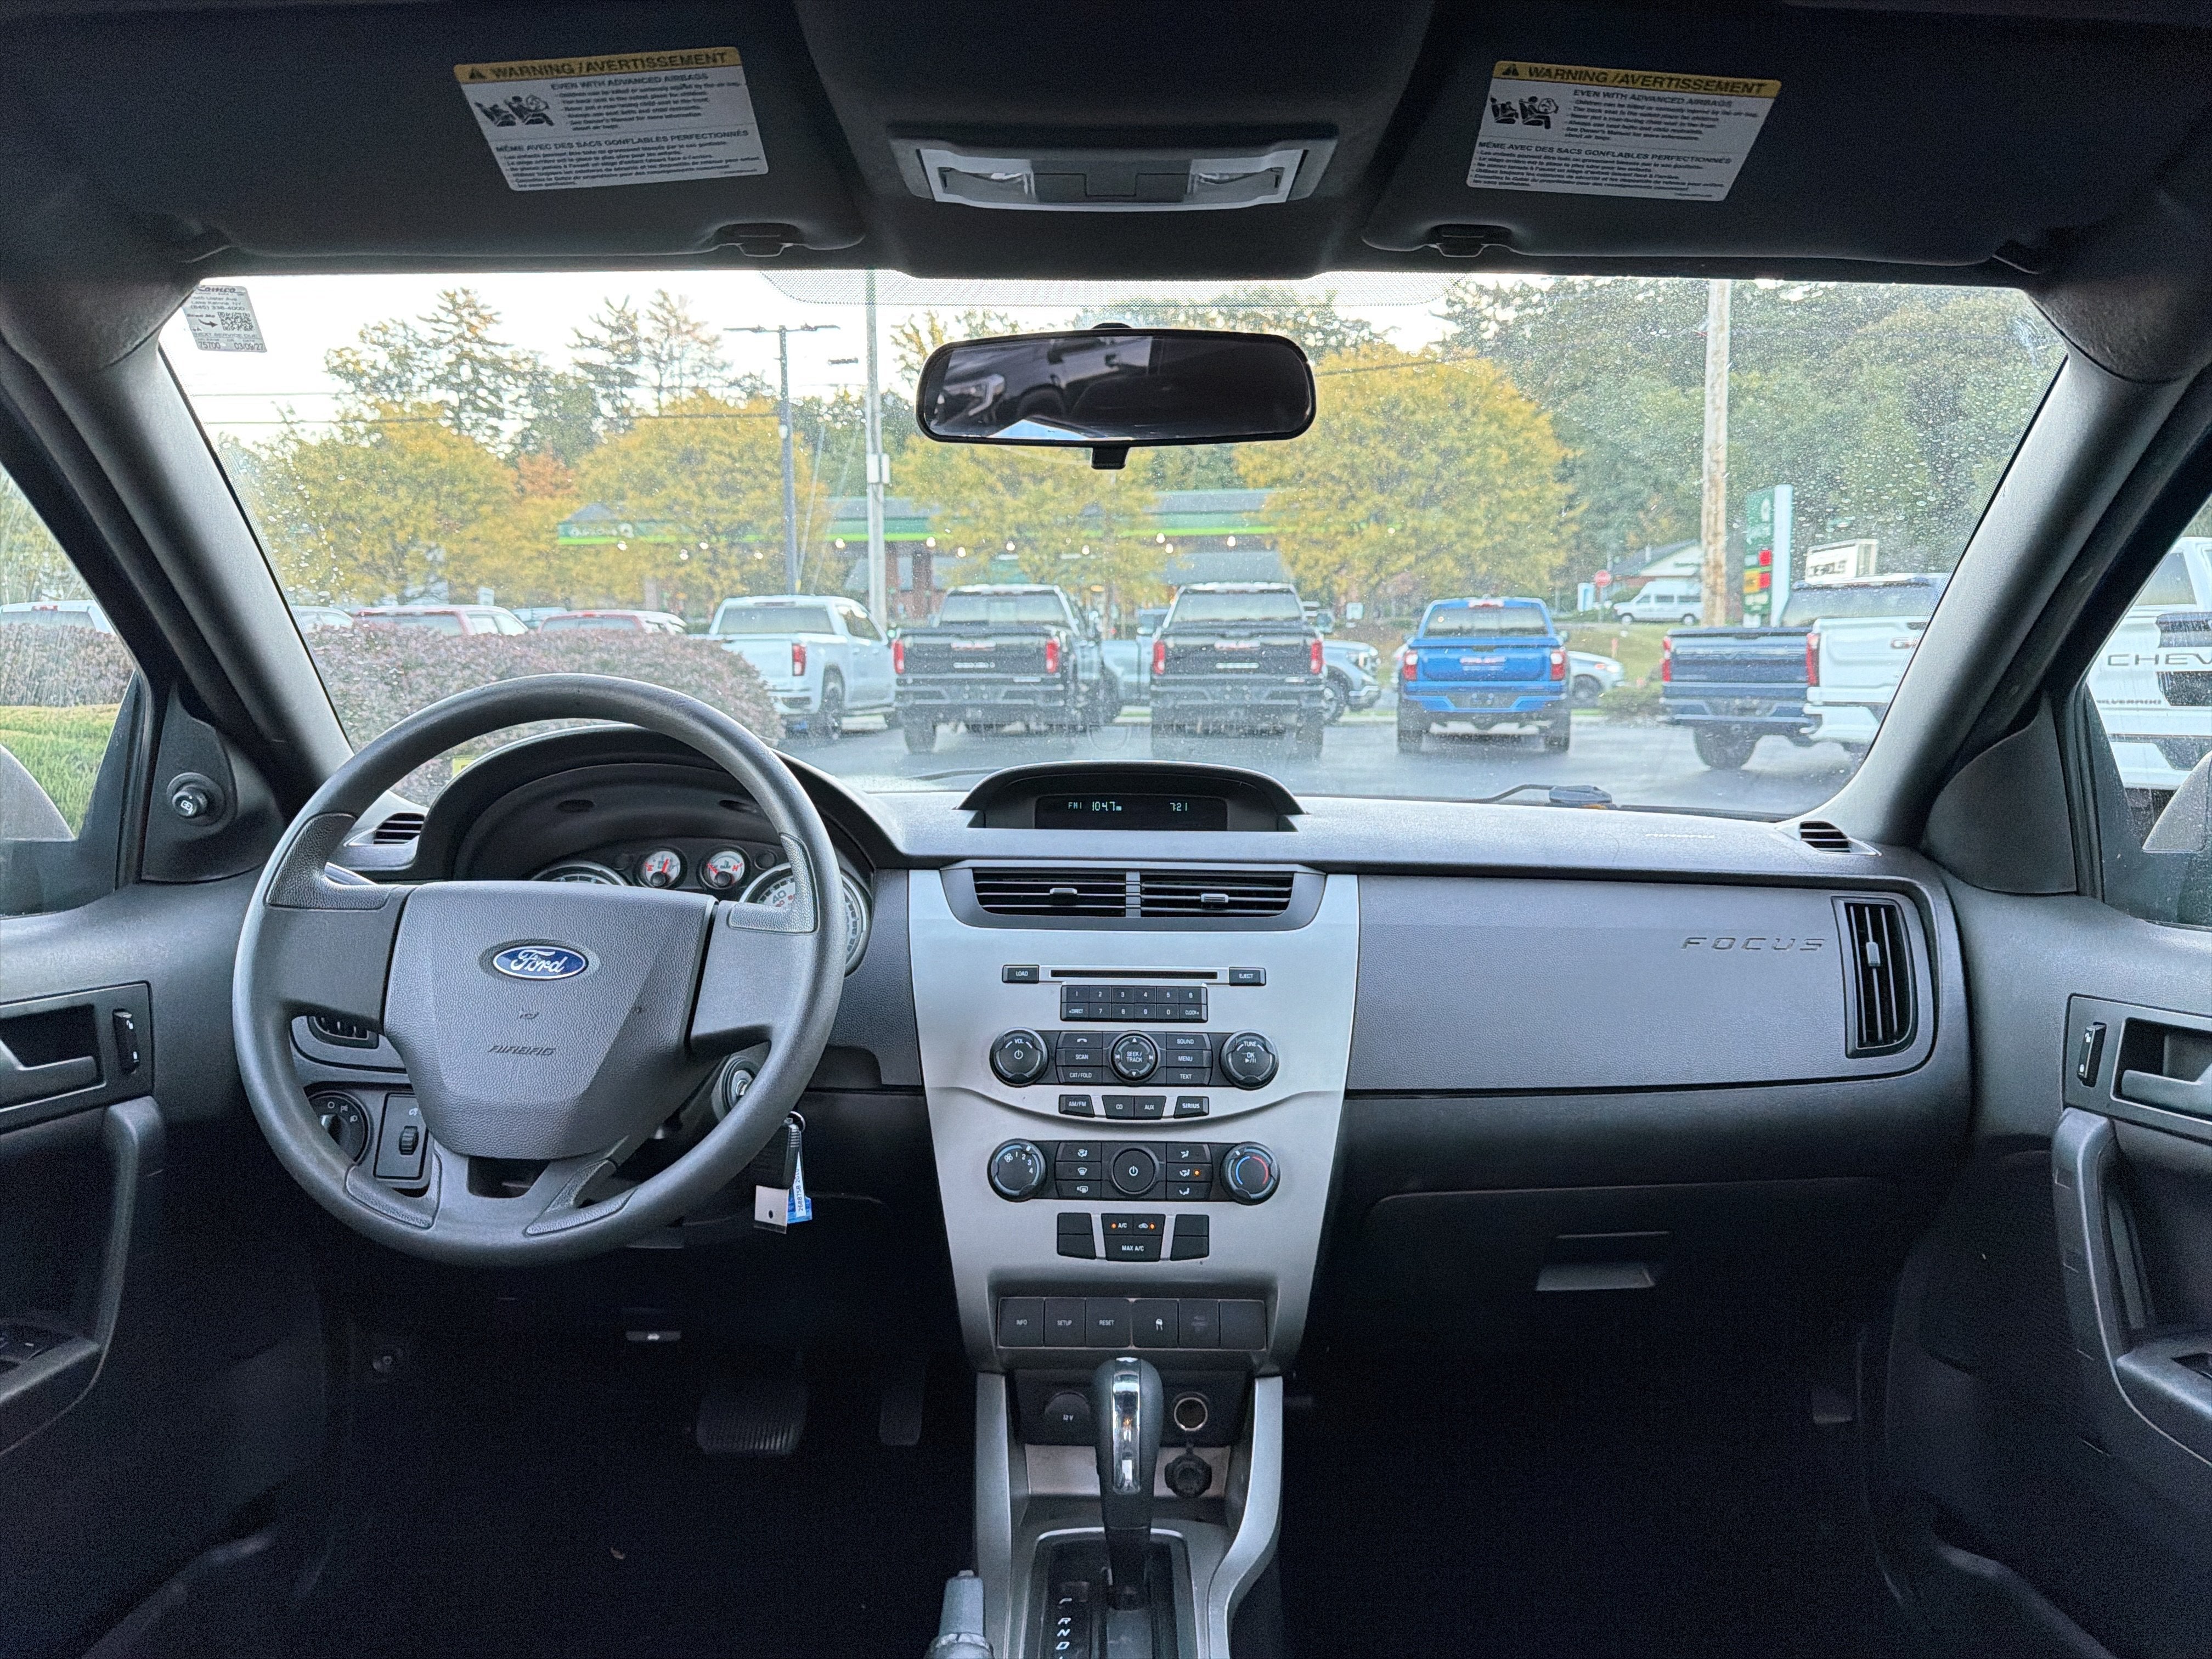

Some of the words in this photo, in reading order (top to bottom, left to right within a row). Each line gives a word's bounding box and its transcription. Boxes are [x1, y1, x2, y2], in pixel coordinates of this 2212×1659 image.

[490, 62, 575, 78] WARNING
[1526, 66, 1610, 83] WARNING
[606, 76, 662, 86] ADVANCED
[1572, 89, 1601, 97] EVEN
[1601, 91, 1628, 99] WITH
[1629, 94, 1686, 104] ADVANCED
[603, 136, 669, 146] GONFLABLES
[1583, 149, 1650, 160] GONFLABLES
[1680, 937, 1825, 951] FOCUS
[510, 950, 567, 973] Ford
[488, 1046, 556, 1055] AIRBAG
[1056, 1641, 1070, 1650] D
